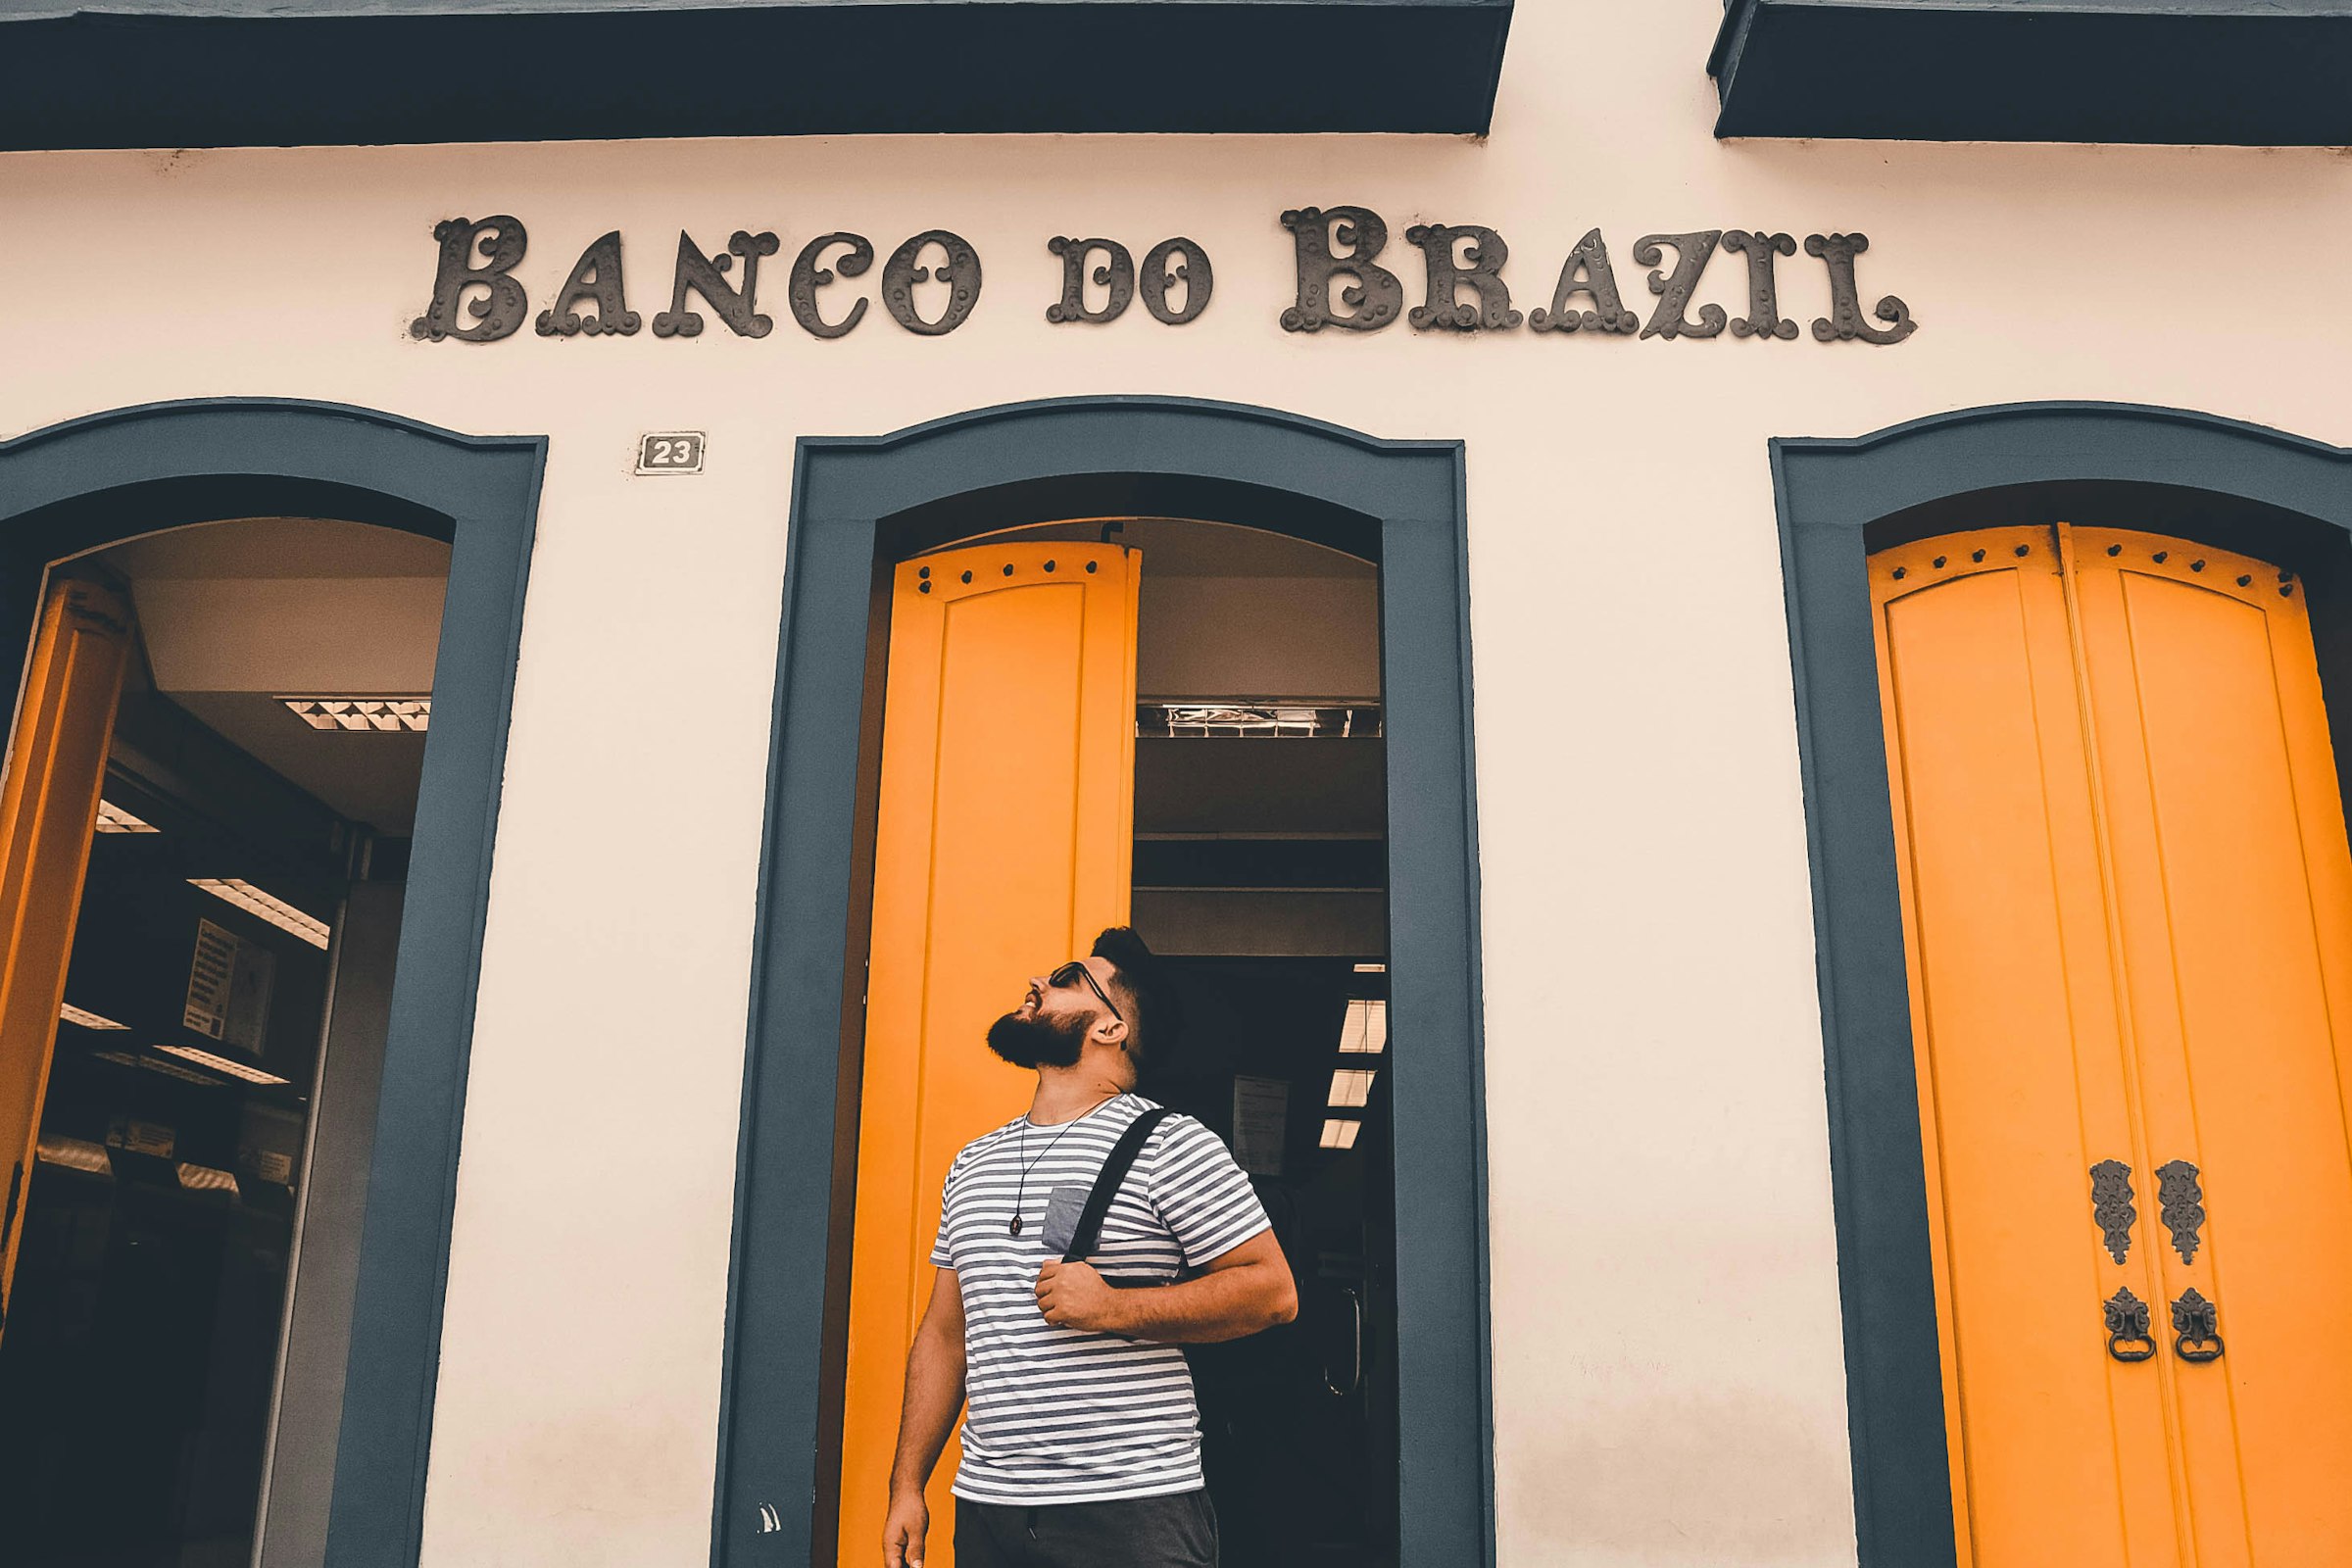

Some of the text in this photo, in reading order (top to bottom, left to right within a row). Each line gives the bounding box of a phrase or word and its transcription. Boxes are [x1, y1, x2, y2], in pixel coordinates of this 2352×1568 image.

[411, 205, 1918, 344] BANCO DO BRAZIL
[652, 440, 691, 464] 23
